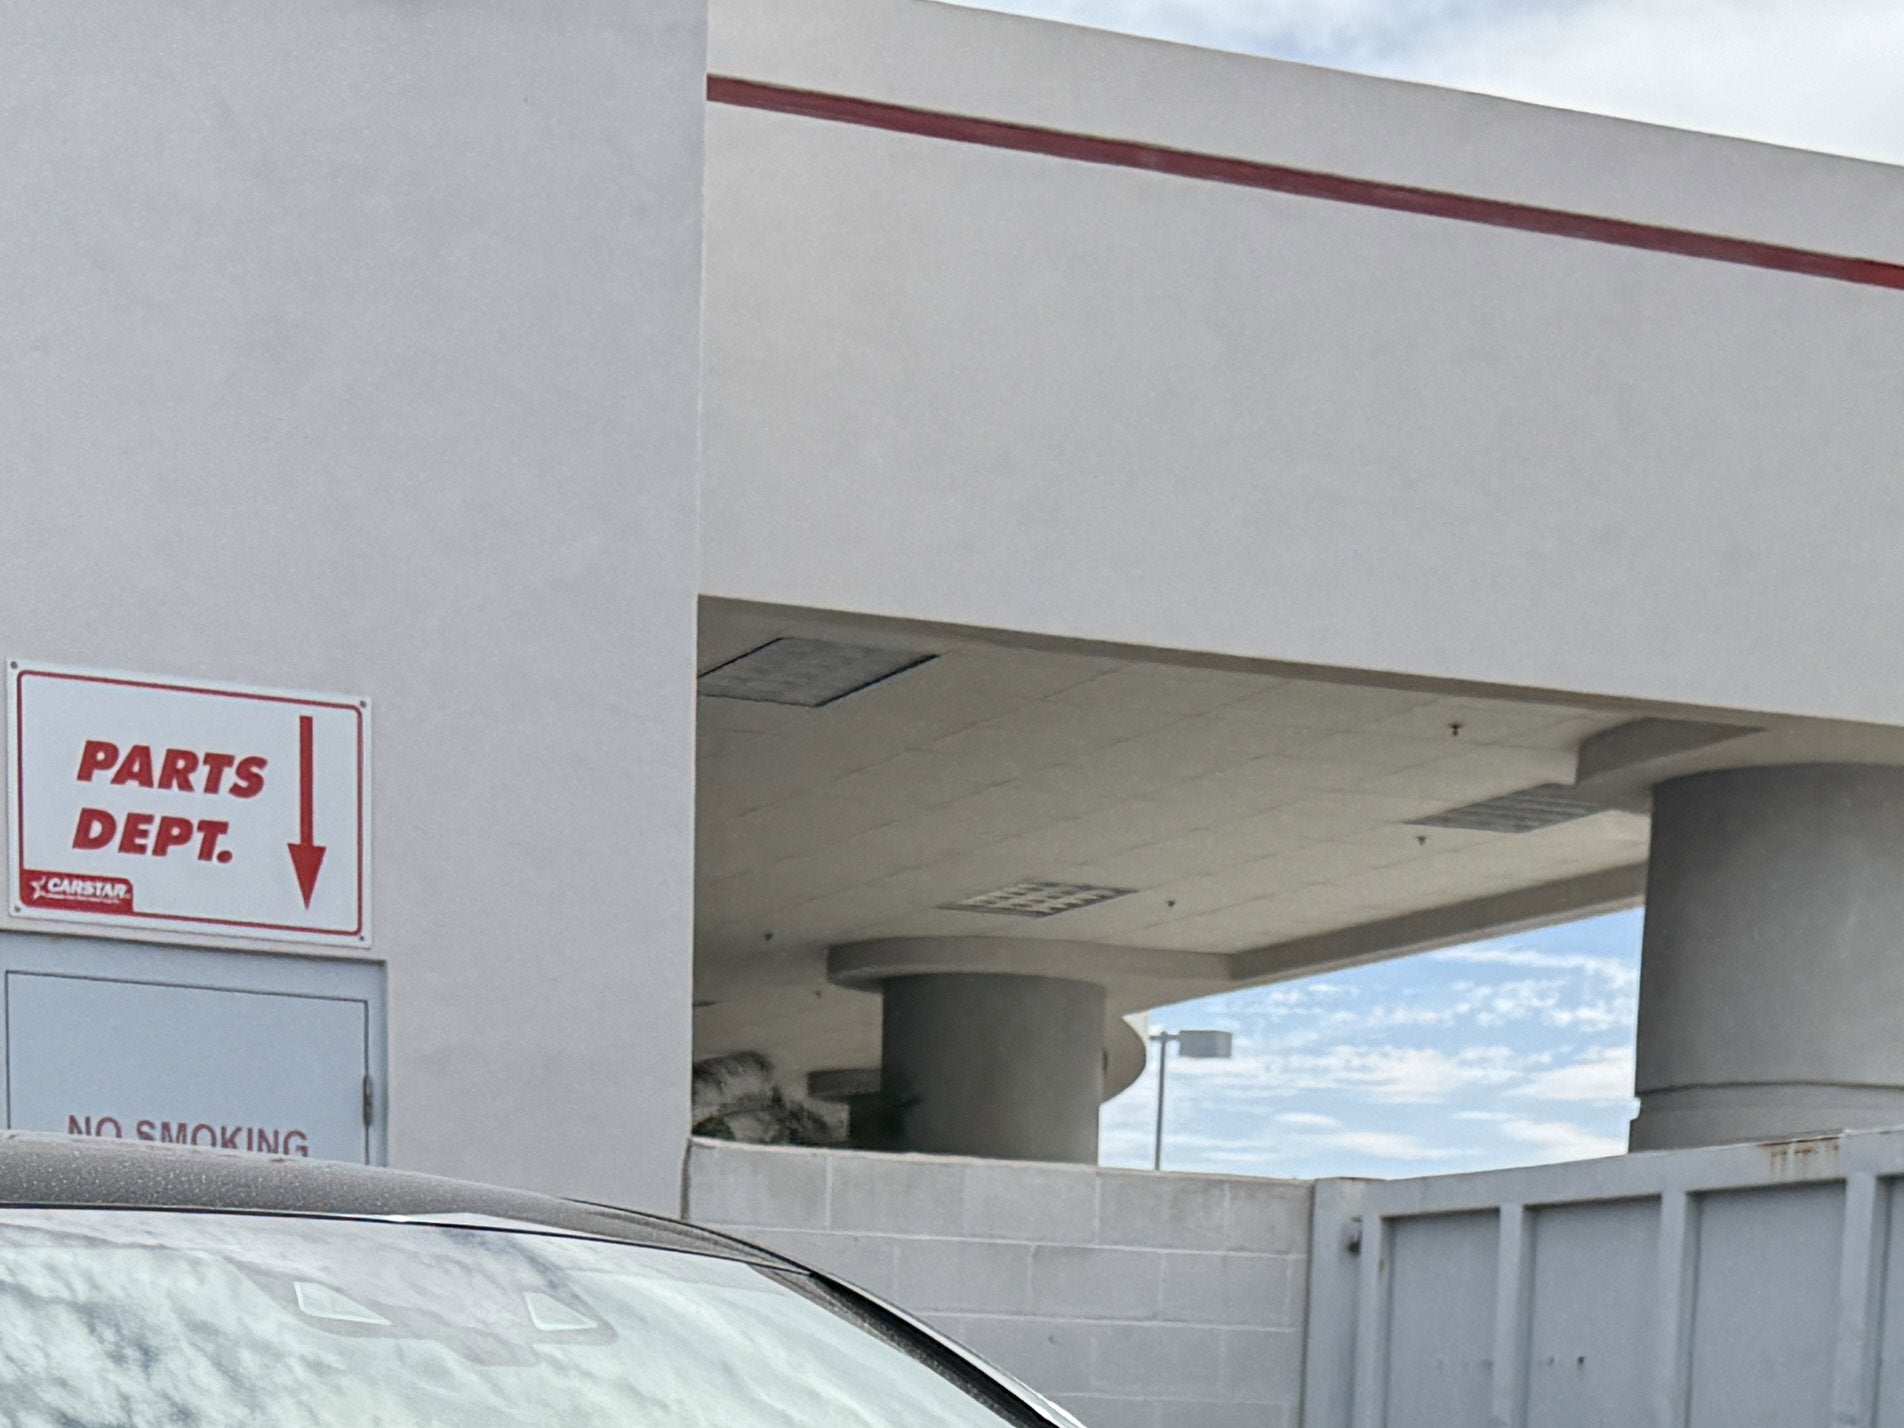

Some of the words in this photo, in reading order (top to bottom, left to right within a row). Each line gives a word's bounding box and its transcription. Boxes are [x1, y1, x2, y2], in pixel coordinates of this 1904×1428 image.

[77, 740, 268, 799] PARTS
[72, 807, 233, 864] DEPT.
[47, 877, 127, 899] CARSTAR
[68, 1115, 122, 1138] NO
[136, 1120, 309, 1157] SMOKING
